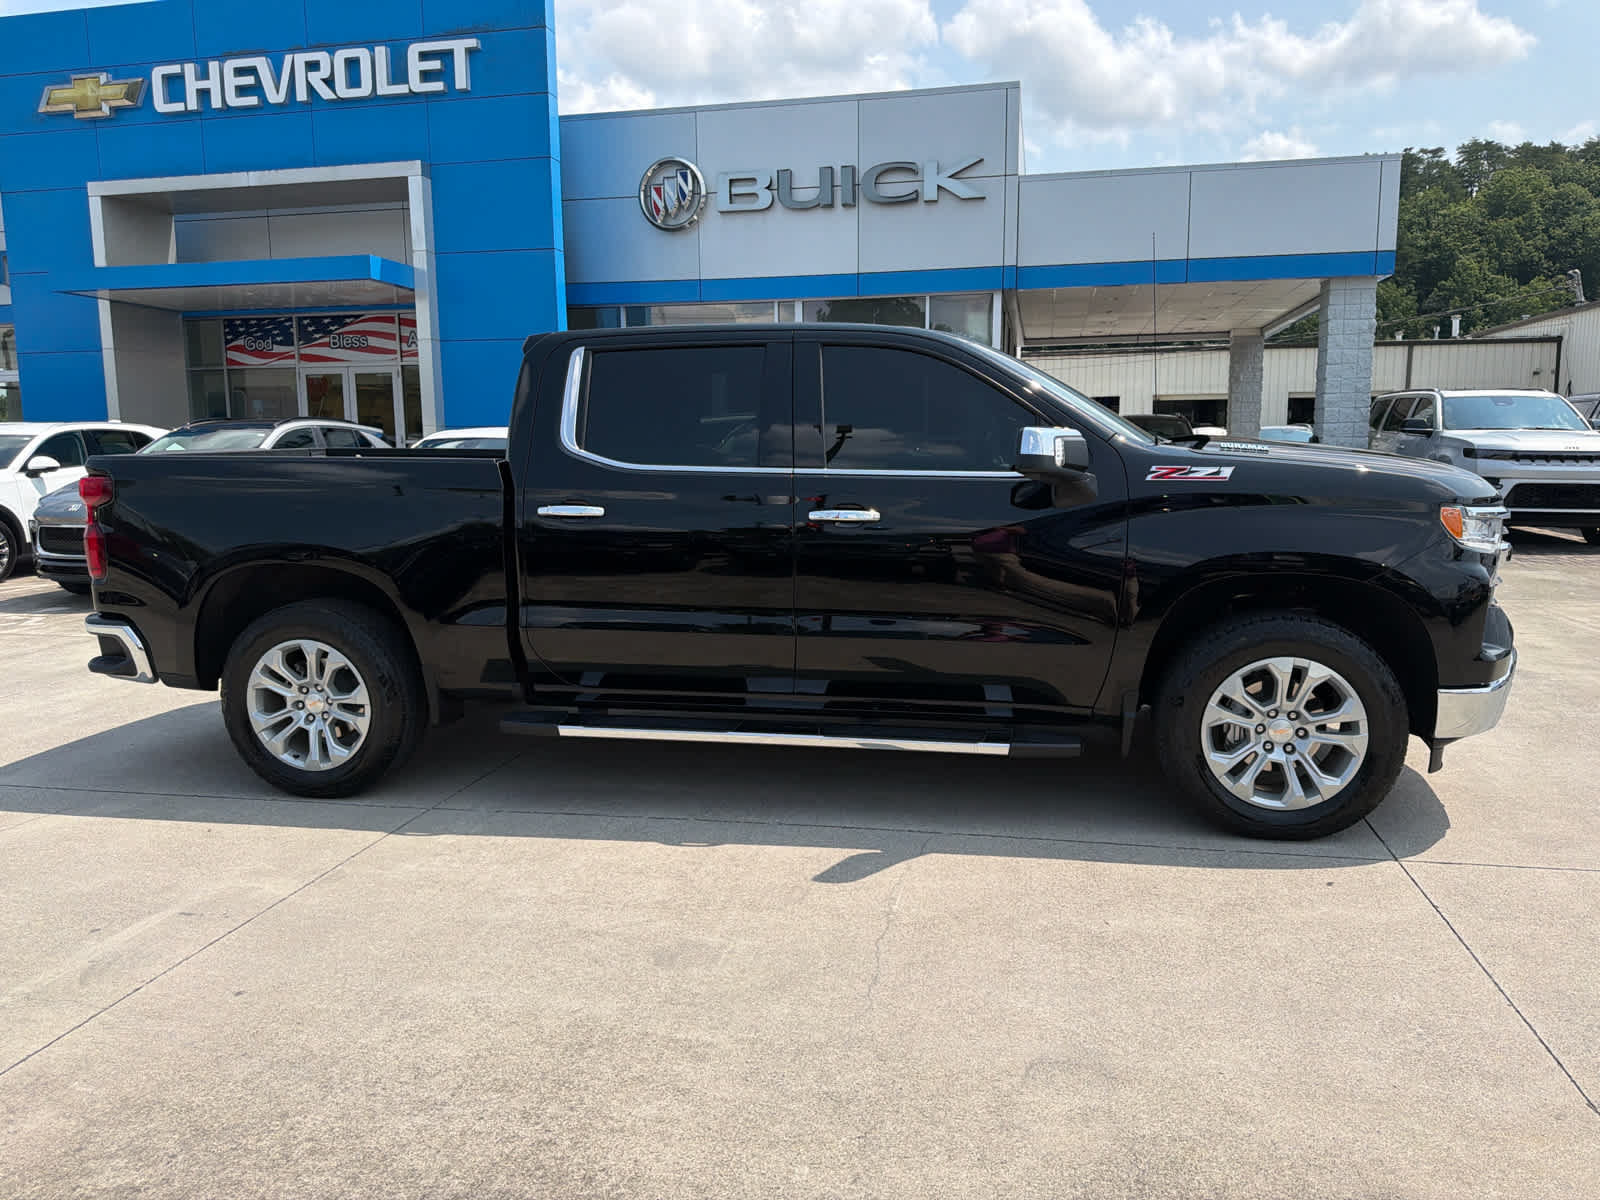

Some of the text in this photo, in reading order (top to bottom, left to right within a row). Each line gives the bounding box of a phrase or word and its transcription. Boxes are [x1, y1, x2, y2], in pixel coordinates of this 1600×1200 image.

[151, 38, 481, 114] CHEVROLET
[717, 157, 987, 214] BUICK
[244, 336, 273, 351] God
[329, 334, 369, 349] Bless
[1145, 465, 1236, 481] Z71
